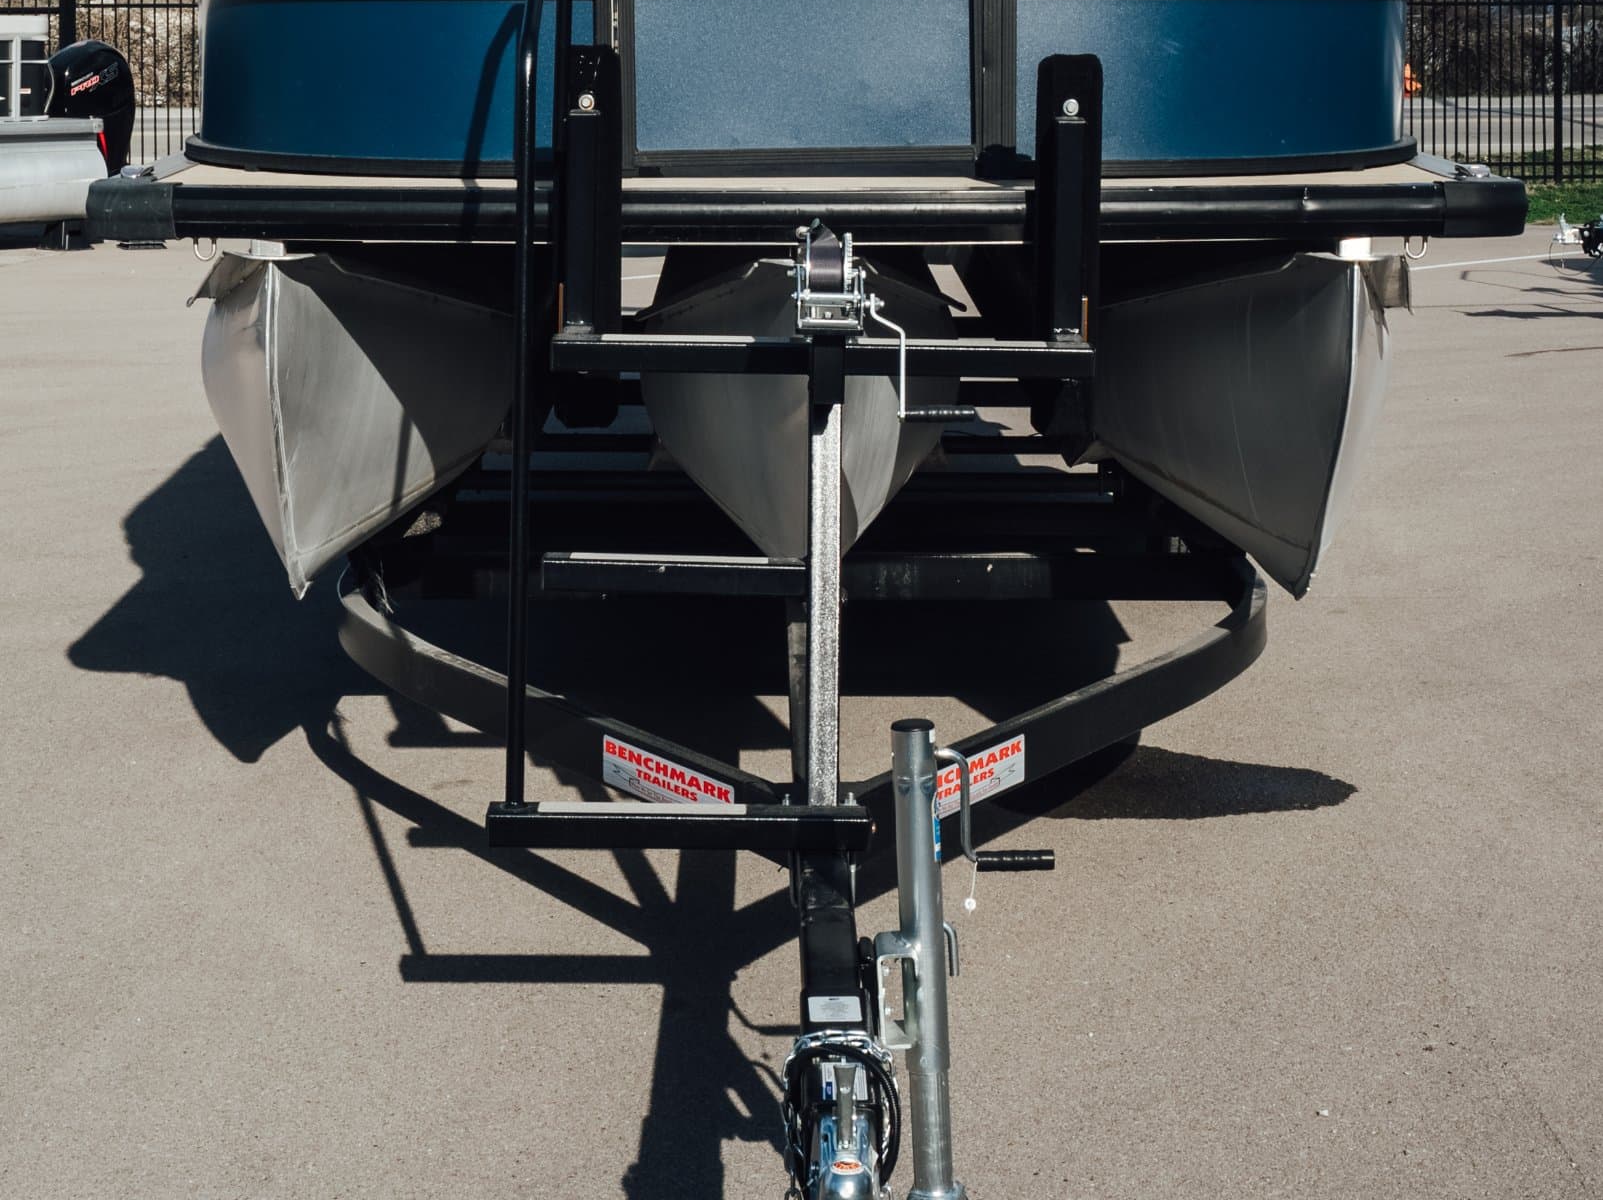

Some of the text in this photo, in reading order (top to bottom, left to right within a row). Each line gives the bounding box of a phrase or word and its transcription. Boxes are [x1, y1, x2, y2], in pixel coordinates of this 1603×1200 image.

[605, 739, 731, 804] BENCHMARK
[635, 768, 699, 802] TRAILERS
[937, 767, 995, 801] TRAERS
